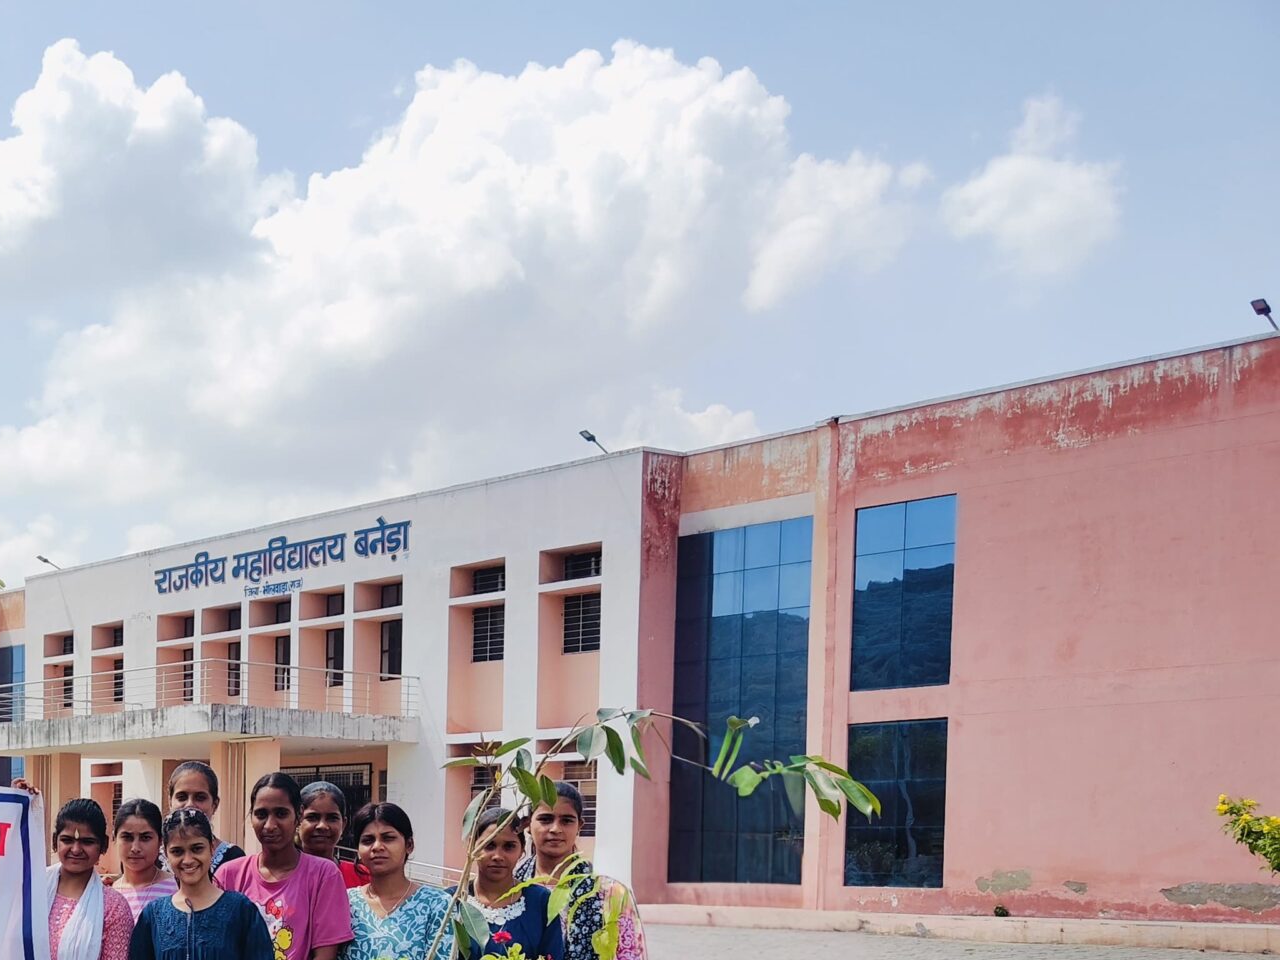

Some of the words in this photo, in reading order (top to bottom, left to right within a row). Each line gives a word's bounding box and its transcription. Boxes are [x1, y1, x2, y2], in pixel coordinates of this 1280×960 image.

[155, 551, 227, 594] राजकीय
[231, 533, 346, 583] महाविद्यालय
[354, 516, 411, 561] बनेड़ा
